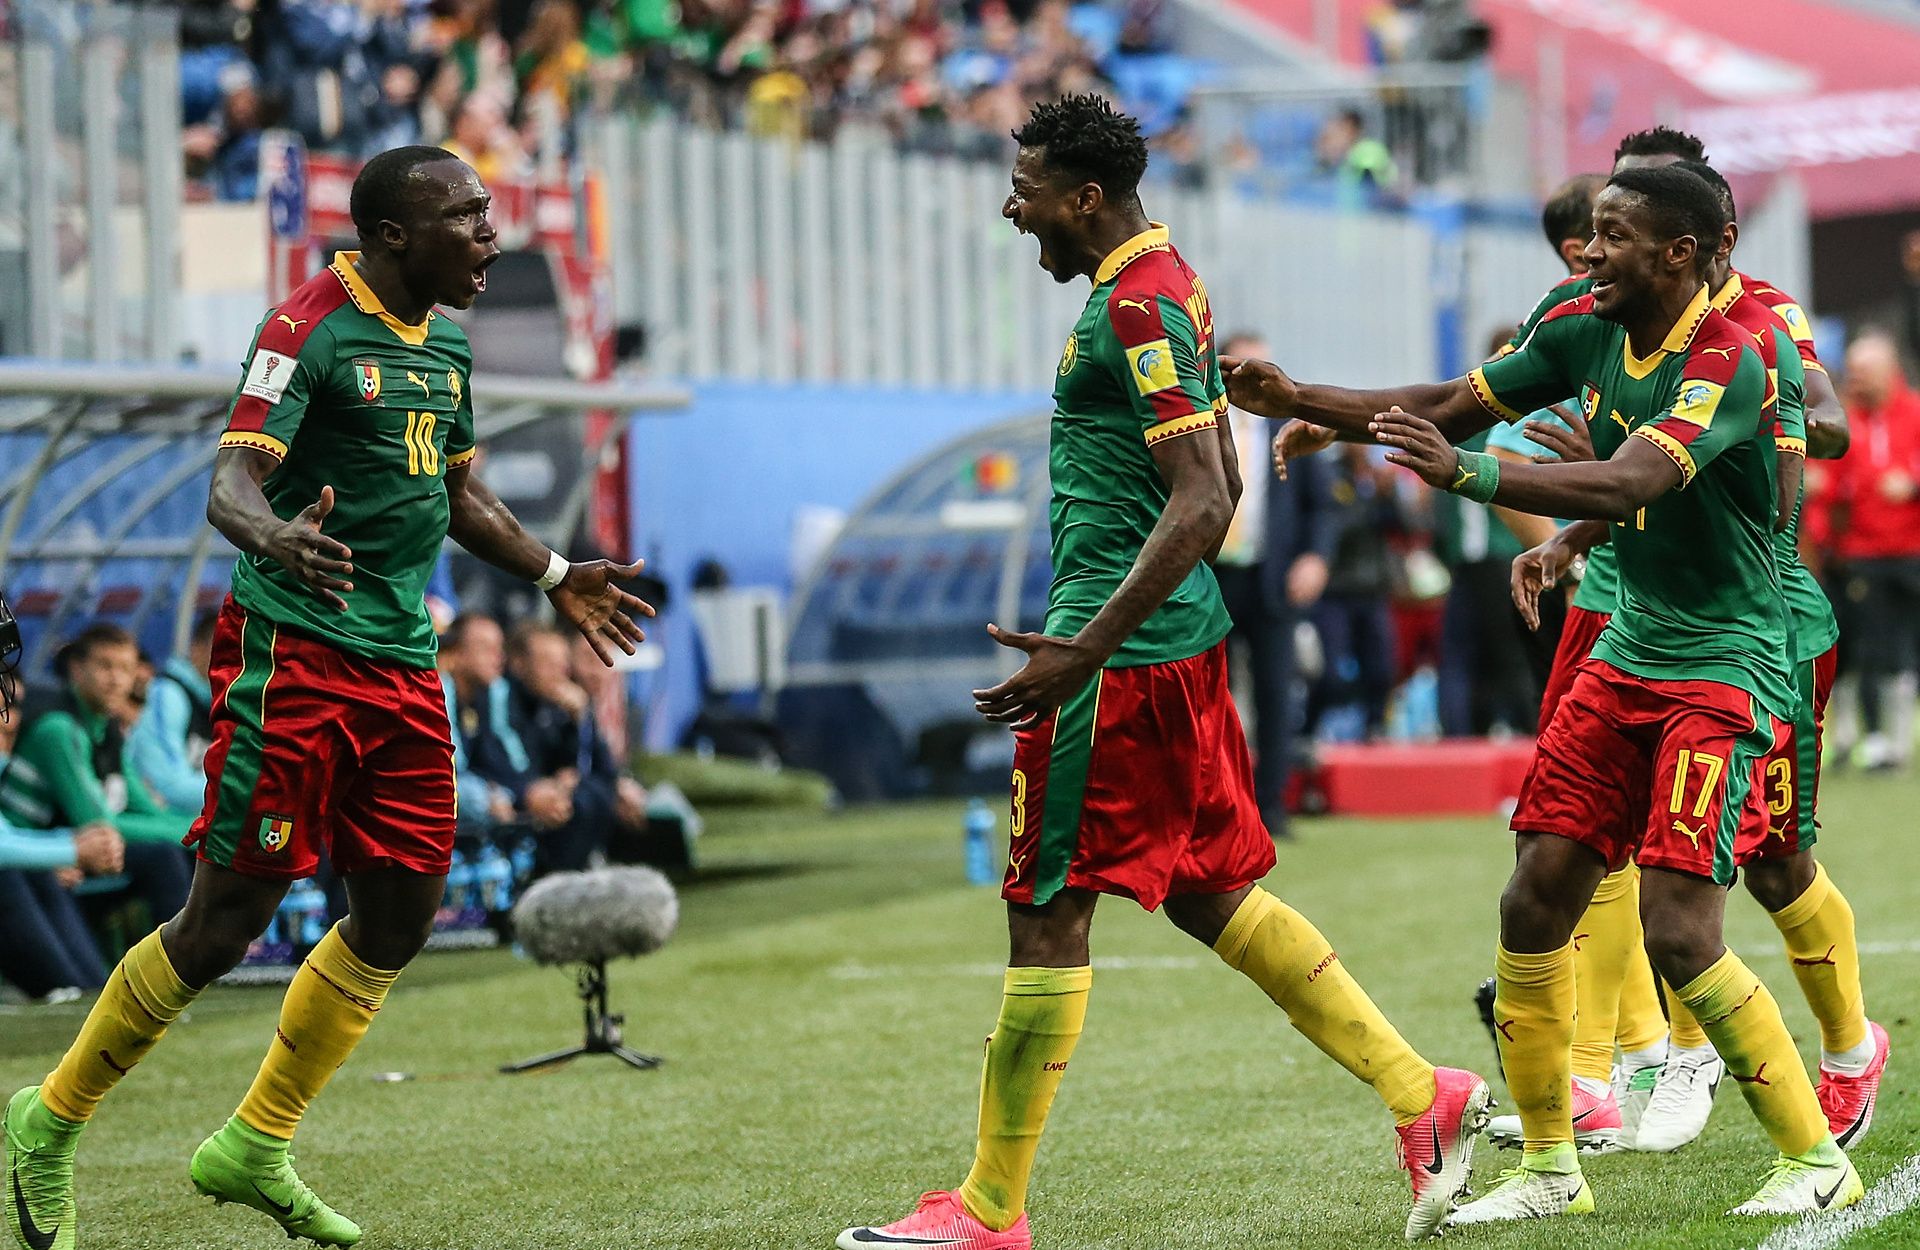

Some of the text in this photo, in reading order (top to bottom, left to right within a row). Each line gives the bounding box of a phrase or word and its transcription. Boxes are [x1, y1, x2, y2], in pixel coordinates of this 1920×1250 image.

[405, 411, 439, 476] 10
[1012, 768, 1027, 837] 3
[1669, 749, 1724, 818] 17
[1766, 757, 1793, 816] 3
